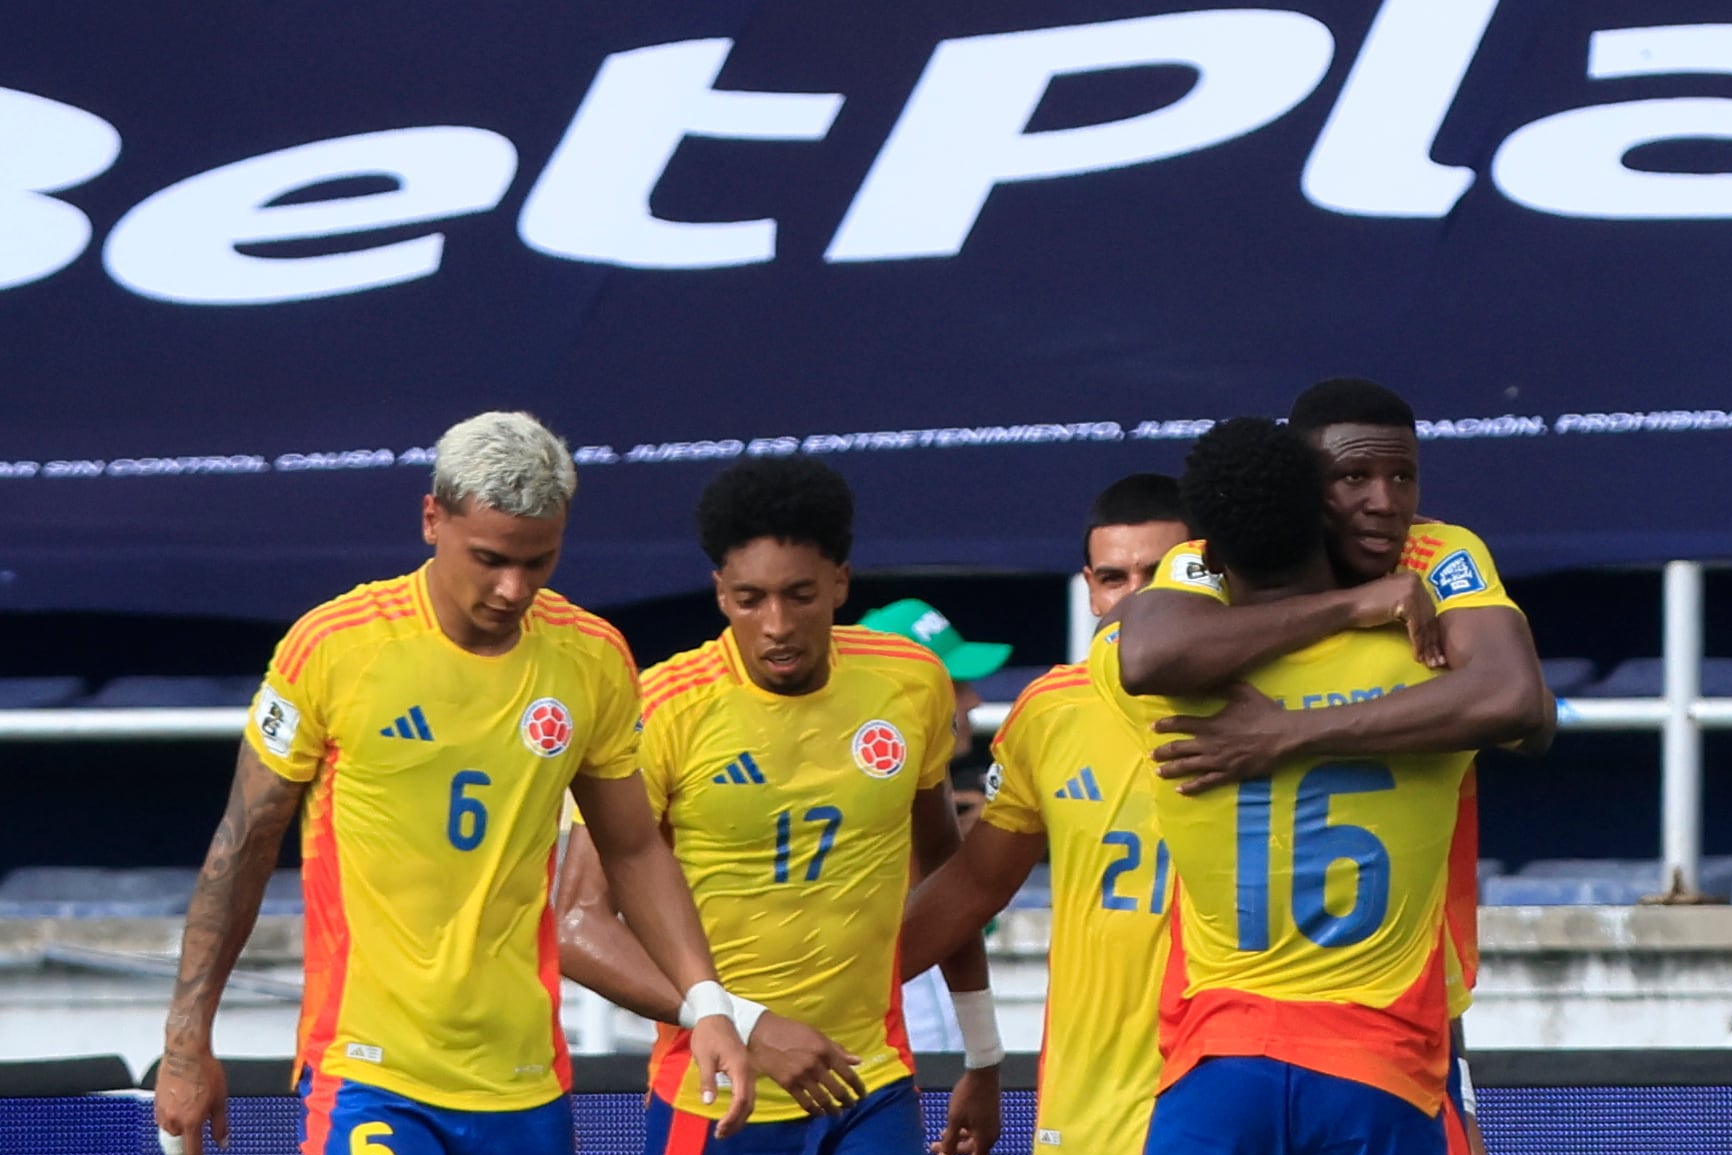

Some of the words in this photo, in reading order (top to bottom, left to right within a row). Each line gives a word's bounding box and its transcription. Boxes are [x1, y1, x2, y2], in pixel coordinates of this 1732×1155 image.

[42, 459, 105, 478] SIN
[105, 455, 270, 477] CONTROL
[273, 448, 396, 472] CAUSA
[624, 439, 746, 463] JUEGO
[746, 436, 800, 458] ES
[446, 768, 492, 852] 6
[773, 805, 843, 883] 17
[1100, 830, 1170, 915] 21
[1235, 761, 1396, 952] 16
